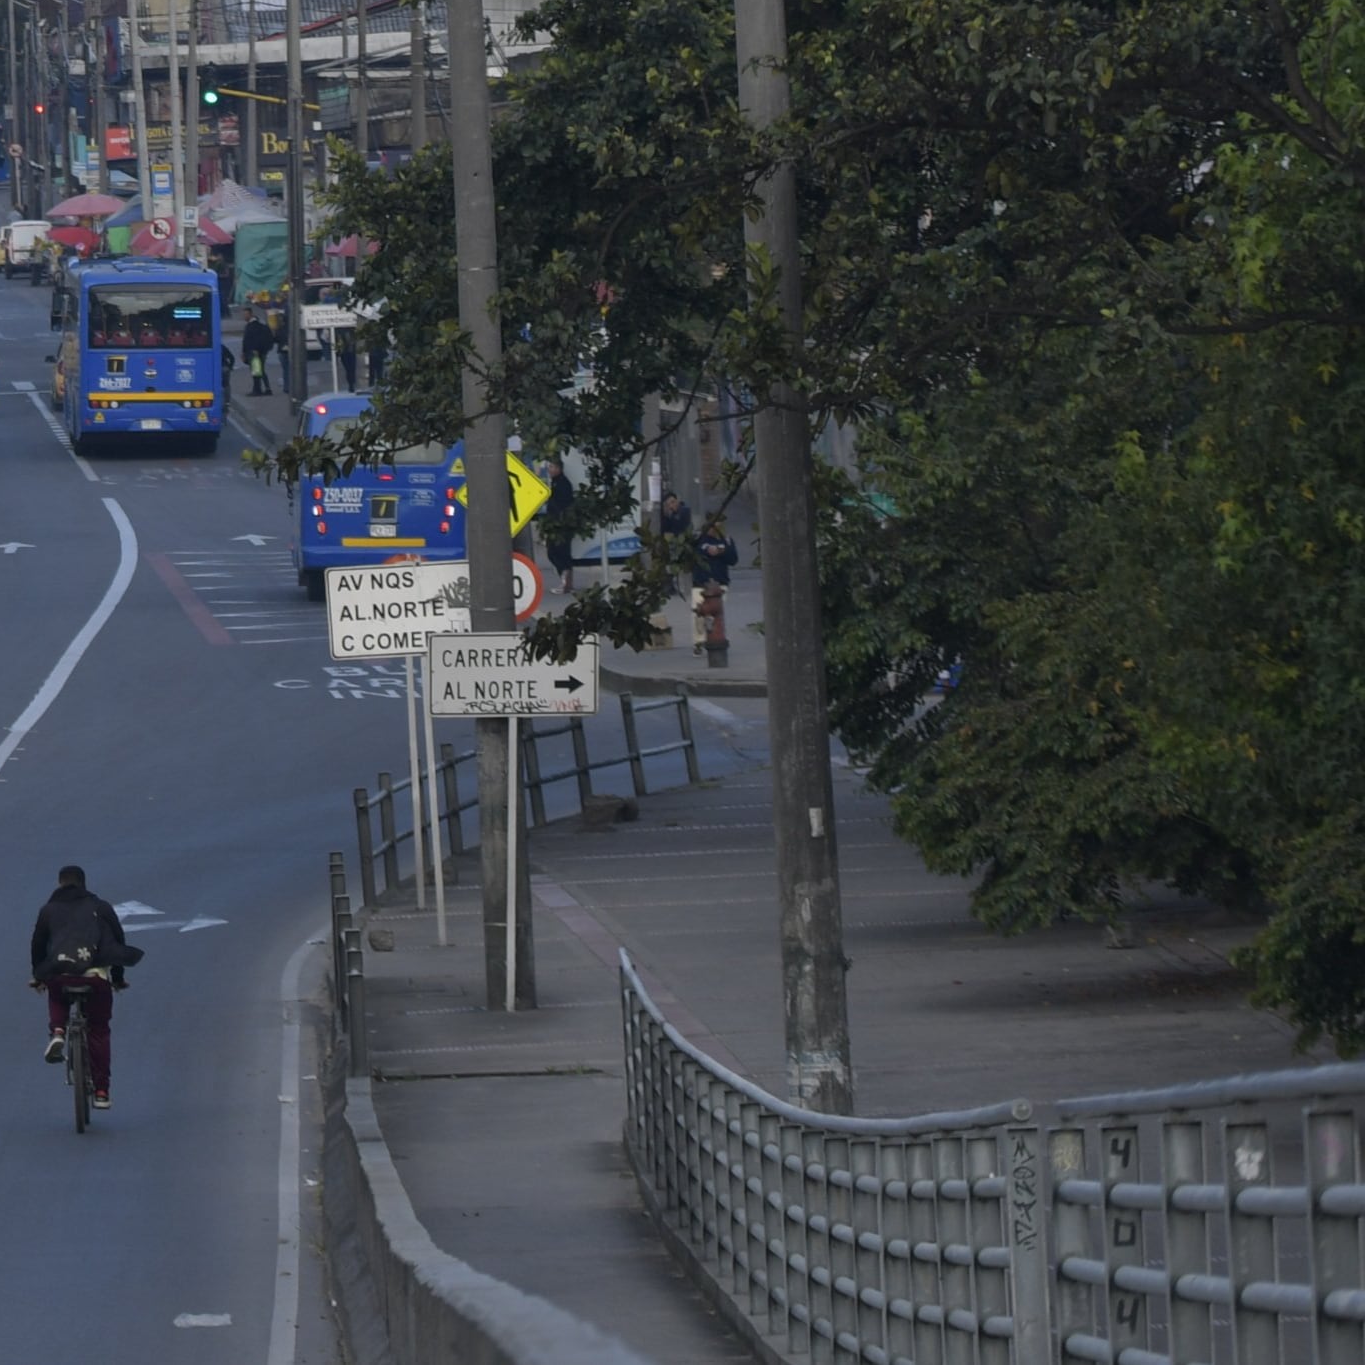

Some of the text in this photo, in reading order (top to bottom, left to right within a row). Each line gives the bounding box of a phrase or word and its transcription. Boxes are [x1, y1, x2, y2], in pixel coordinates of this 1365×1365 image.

[338, 571, 414, 592] AV NQS
[342, 635, 355, 652] C
[443, 649, 533, 668] CARRERA
[443, 680, 538, 701] AL NORTE
